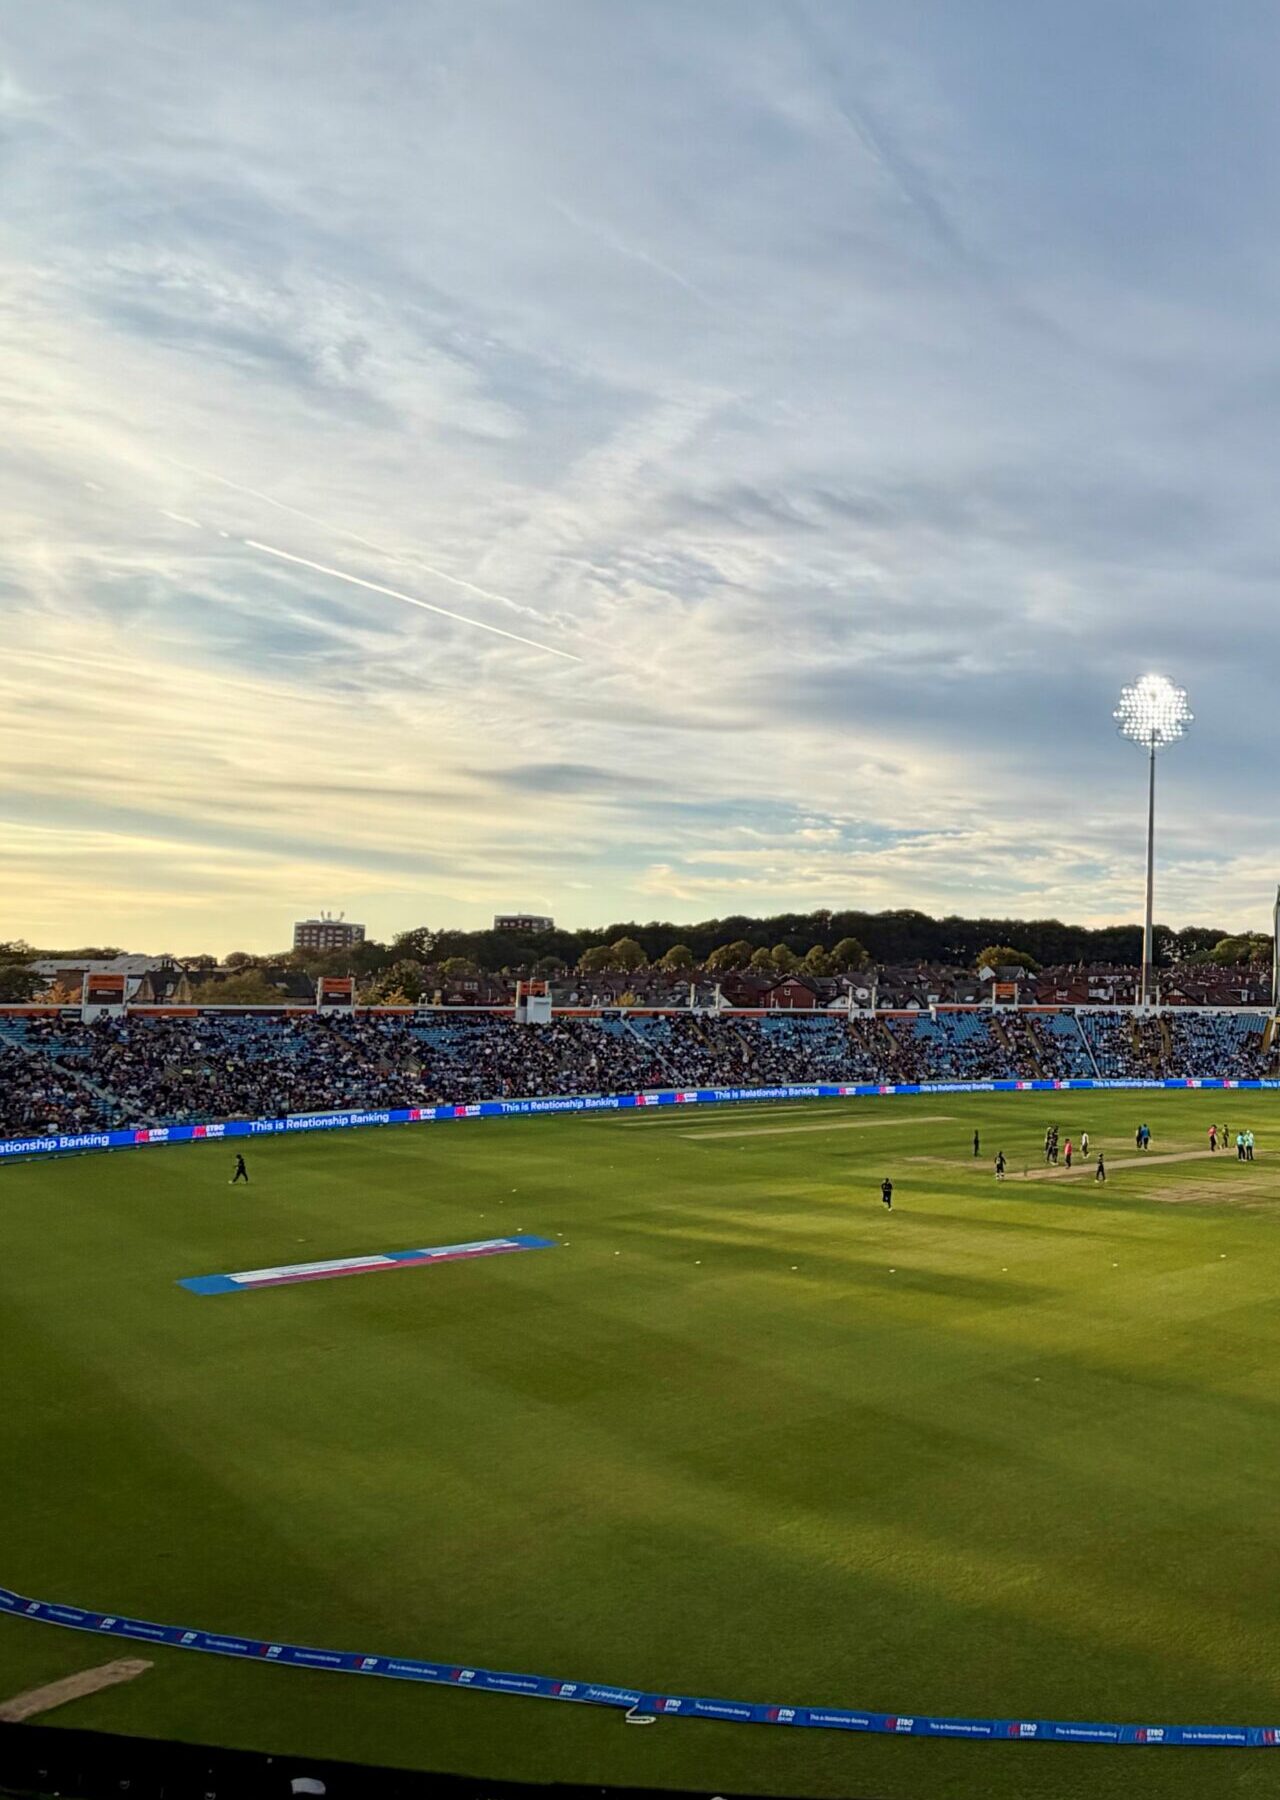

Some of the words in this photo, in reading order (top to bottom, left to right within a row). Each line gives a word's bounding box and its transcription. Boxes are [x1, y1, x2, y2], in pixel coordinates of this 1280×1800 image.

[501, 1101, 521, 1112] This
[521, 1101, 529, 1111] is
[531, 1098, 584, 1110] Relationship
[585, 1097, 619, 1107] Banking
[250, 1121, 273, 1132] This
[275, 1120, 285, 1130] is
[286, 1116, 349, 1129] Relationship
[350, 1112, 389, 1124] Banking
[59, 1134, 110, 1147] Banking
